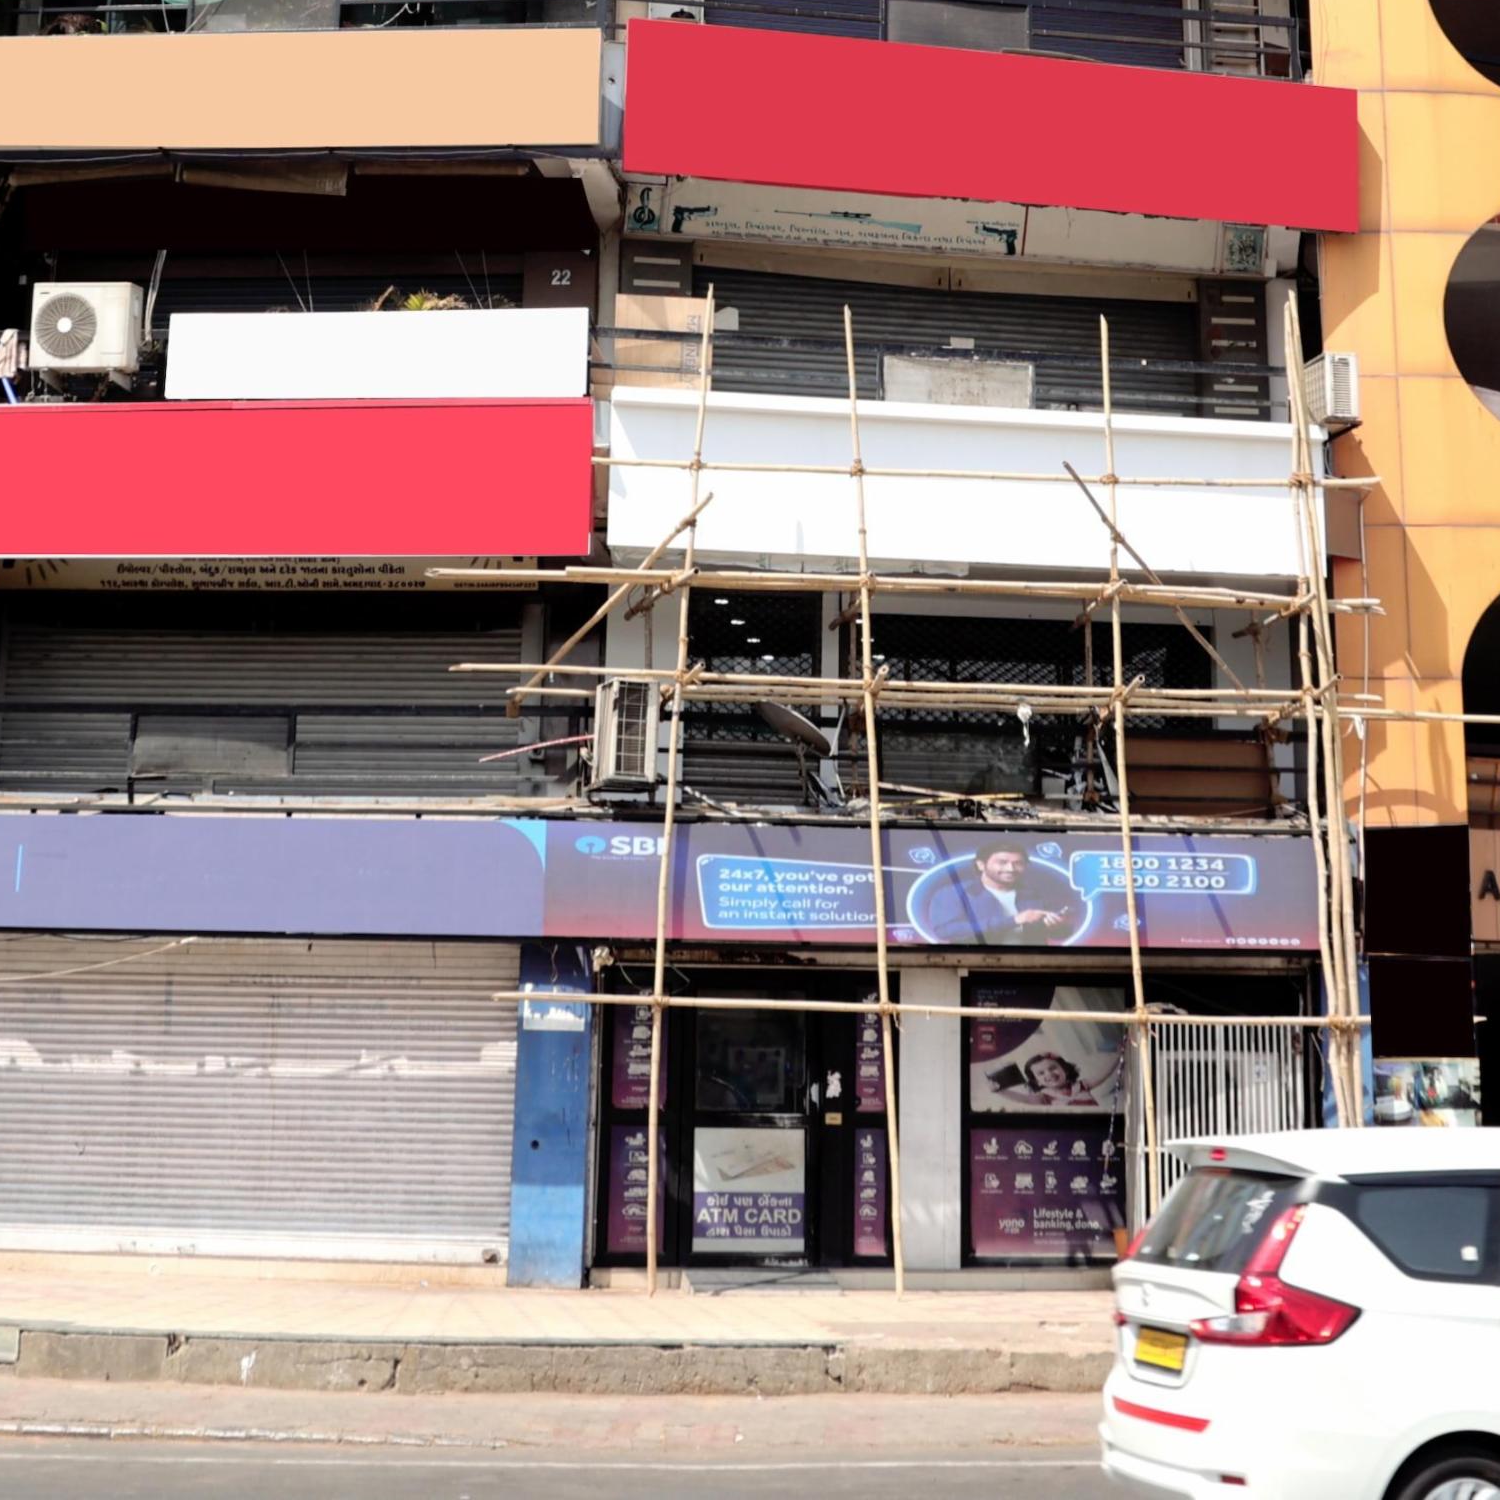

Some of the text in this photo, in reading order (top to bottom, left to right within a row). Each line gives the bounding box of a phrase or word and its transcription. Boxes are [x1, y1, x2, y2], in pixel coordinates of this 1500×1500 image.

[551, 269, 571, 285] 22
[1167, 857, 1225, 872] 1234
[718, 868, 877, 885] 24x7, you've got
[1166, 874, 1226, 889] 2100
[718, 881, 855, 895] our attention.
[718, 896, 840, 910] Simply call for
[718, 909, 740, 920] an
[743, 908, 805, 921] instant
[733, 1195, 753, 1207] પણ
[696, 1208, 802, 1224] ATM CARD
[1033, 1208, 1083, 1219] Lifestyle &
[999, 1218, 1025, 1229] yono
[1033, 1219, 1074, 1231] banking,
